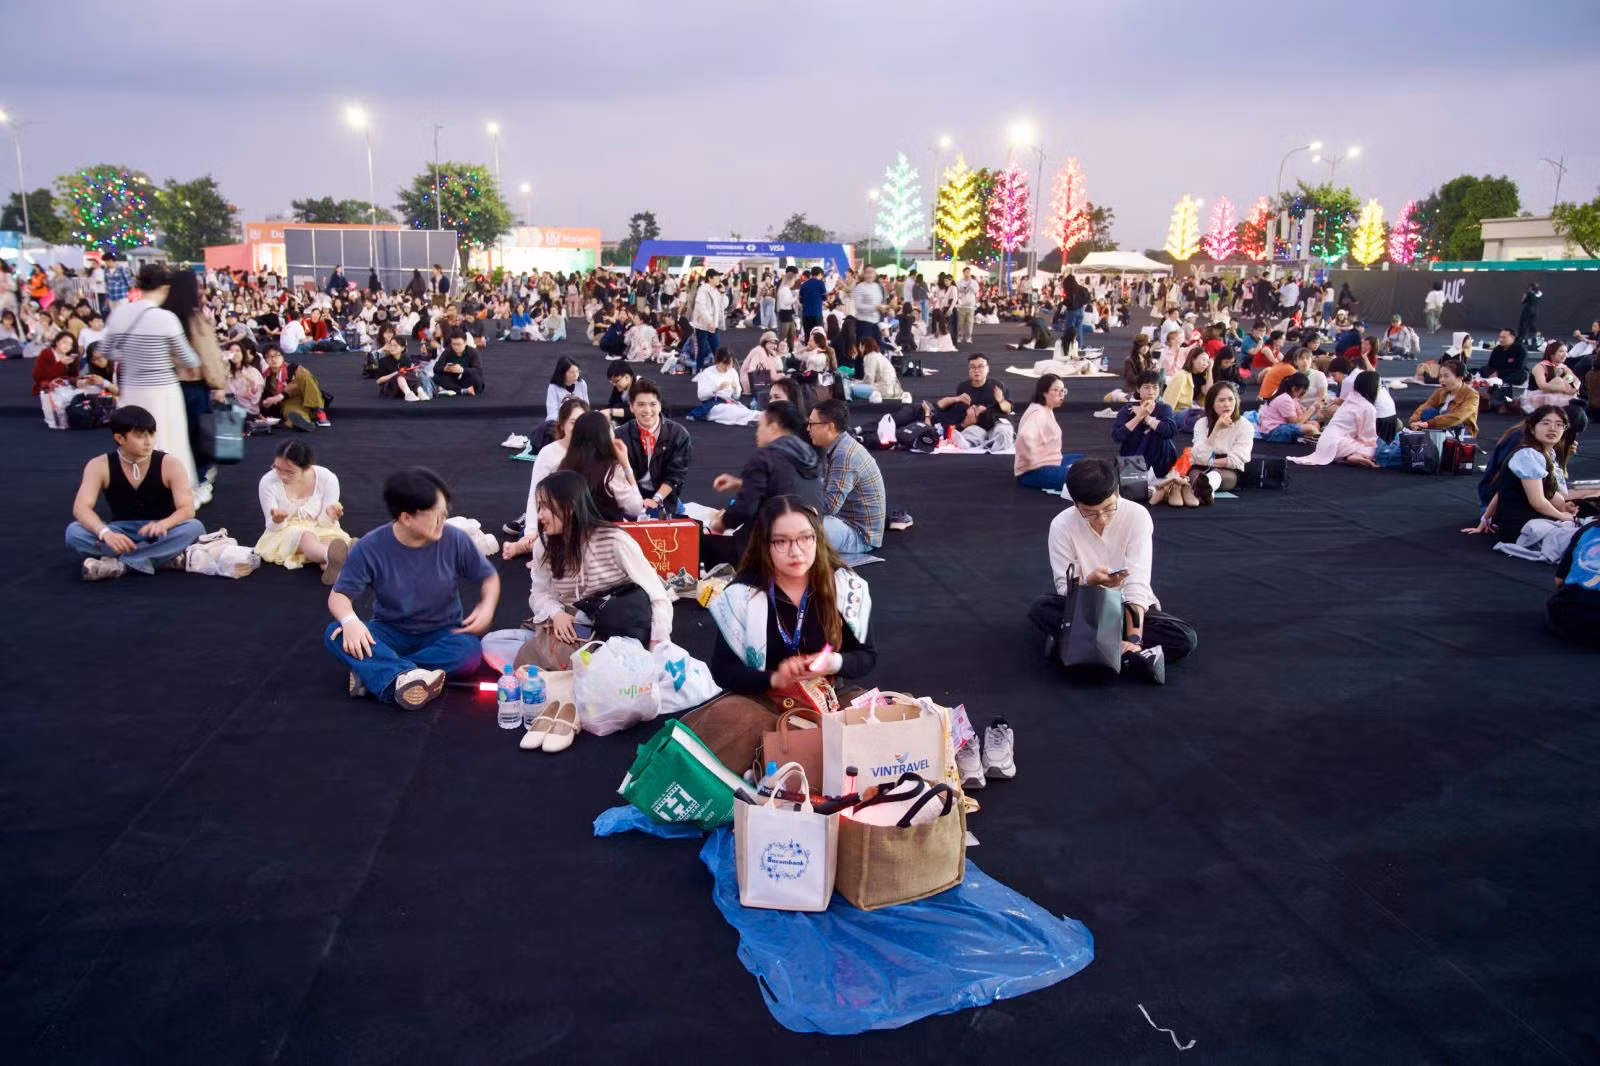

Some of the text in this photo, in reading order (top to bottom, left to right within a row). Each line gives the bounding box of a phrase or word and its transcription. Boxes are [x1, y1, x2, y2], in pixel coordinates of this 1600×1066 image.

[768, 244, 785, 252] VISA
[1442, 278, 1466, 304] WC
[869, 759, 930, 778] VINTRAVEL
[767, 856, 804, 866] Sacombank
